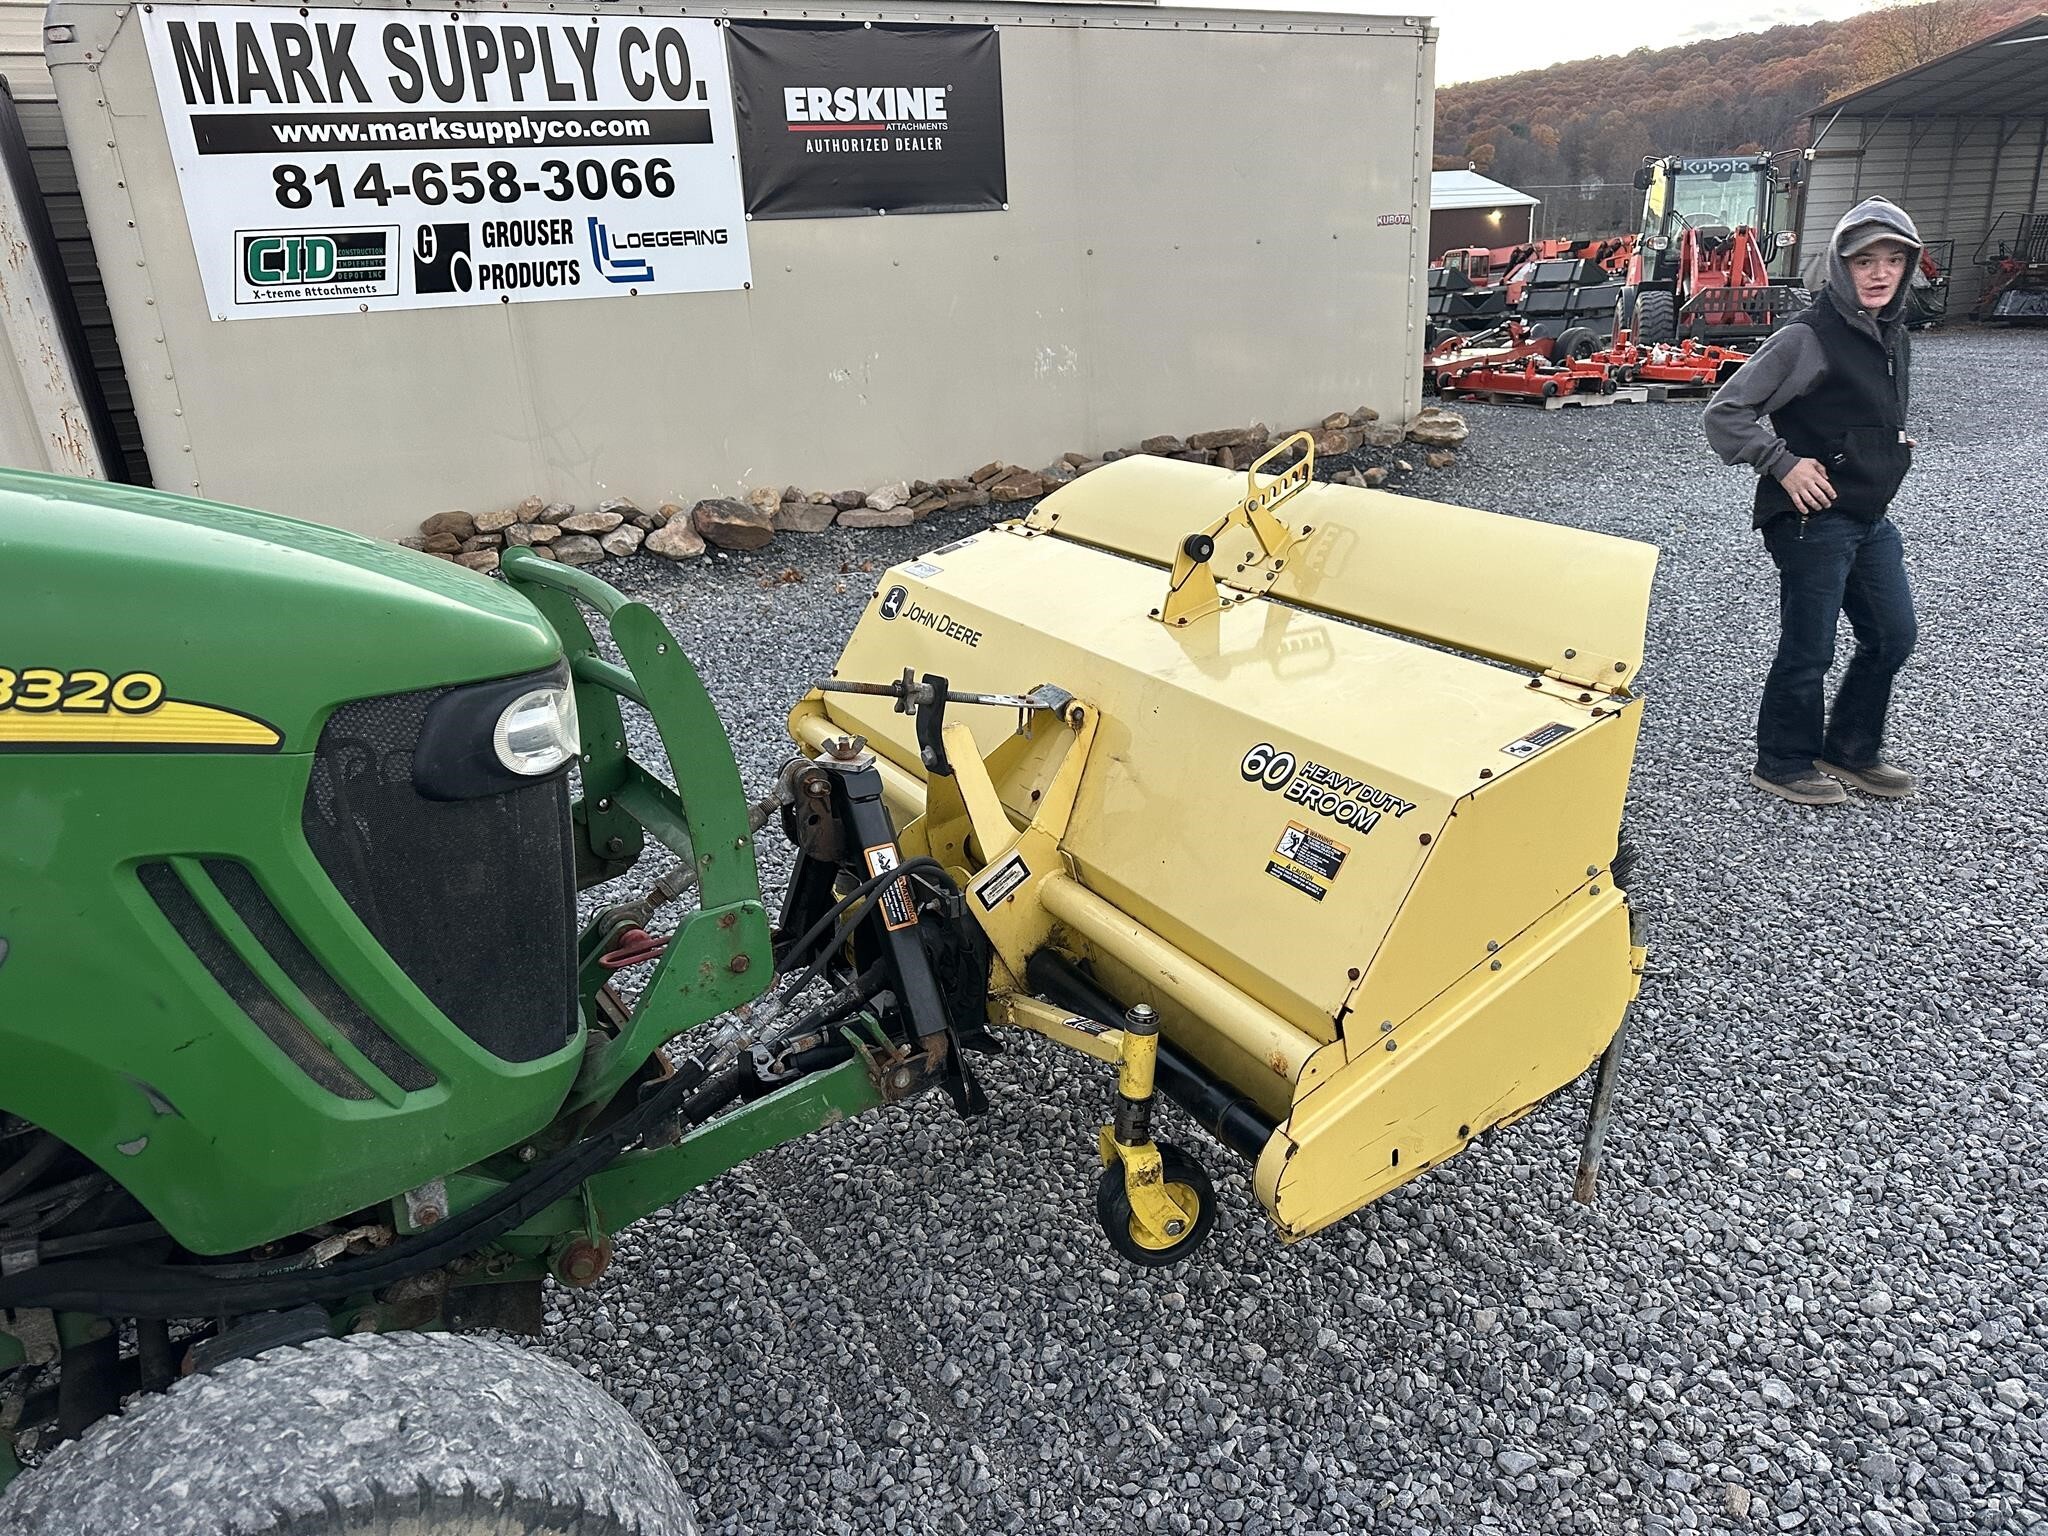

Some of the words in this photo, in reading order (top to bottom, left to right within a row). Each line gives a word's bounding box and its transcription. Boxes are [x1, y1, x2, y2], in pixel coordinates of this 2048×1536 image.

[167, 21, 372, 105] MARK
[382, 24, 601, 104] SUPPLY
[618, 26, 708, 103] CO.
[783, 87, 948, 122] ERSKINE
[272, 116, 650, 146] www.marksupplyco.com
[886, 122, 948, 131] ATTACHMENTS
[806, 138, 889, 153] AUTHORIZED
[896, 137, 942, 152] DEALER
[1683, 160, 1750, 173] Kubota
[272, 157, 676, 209] 814-658-3066
[482, 218, 574, 248] GROUSER
[1377, 213, 1411, 226] KUBOTA
[338, 247, 384, 257] CONSTRUCTION
[611, 229, 728, 249] LOEGERING
[248, 236, 336, 284] CID
[478, 259, 580, 290] PRODUCTS
[338, 272, 363, 280] DEPOT
[368, 271, 382, 279] INC
[253, 289, 301, 300] X-treme
[304, 284, 377, 297] Attachments
[902, 602, 939, 629] JOHN
[936, 614, 983, 648] DEERE
[1241, 742, 1296, 791] 60
[1300, 761, 1363, 796] HEAVY
[1358, 784, 1416, 818] DUTY
[1284, 777, 1381, 835] BROOM
[1291, 866, 1314, 881] CAUTION
